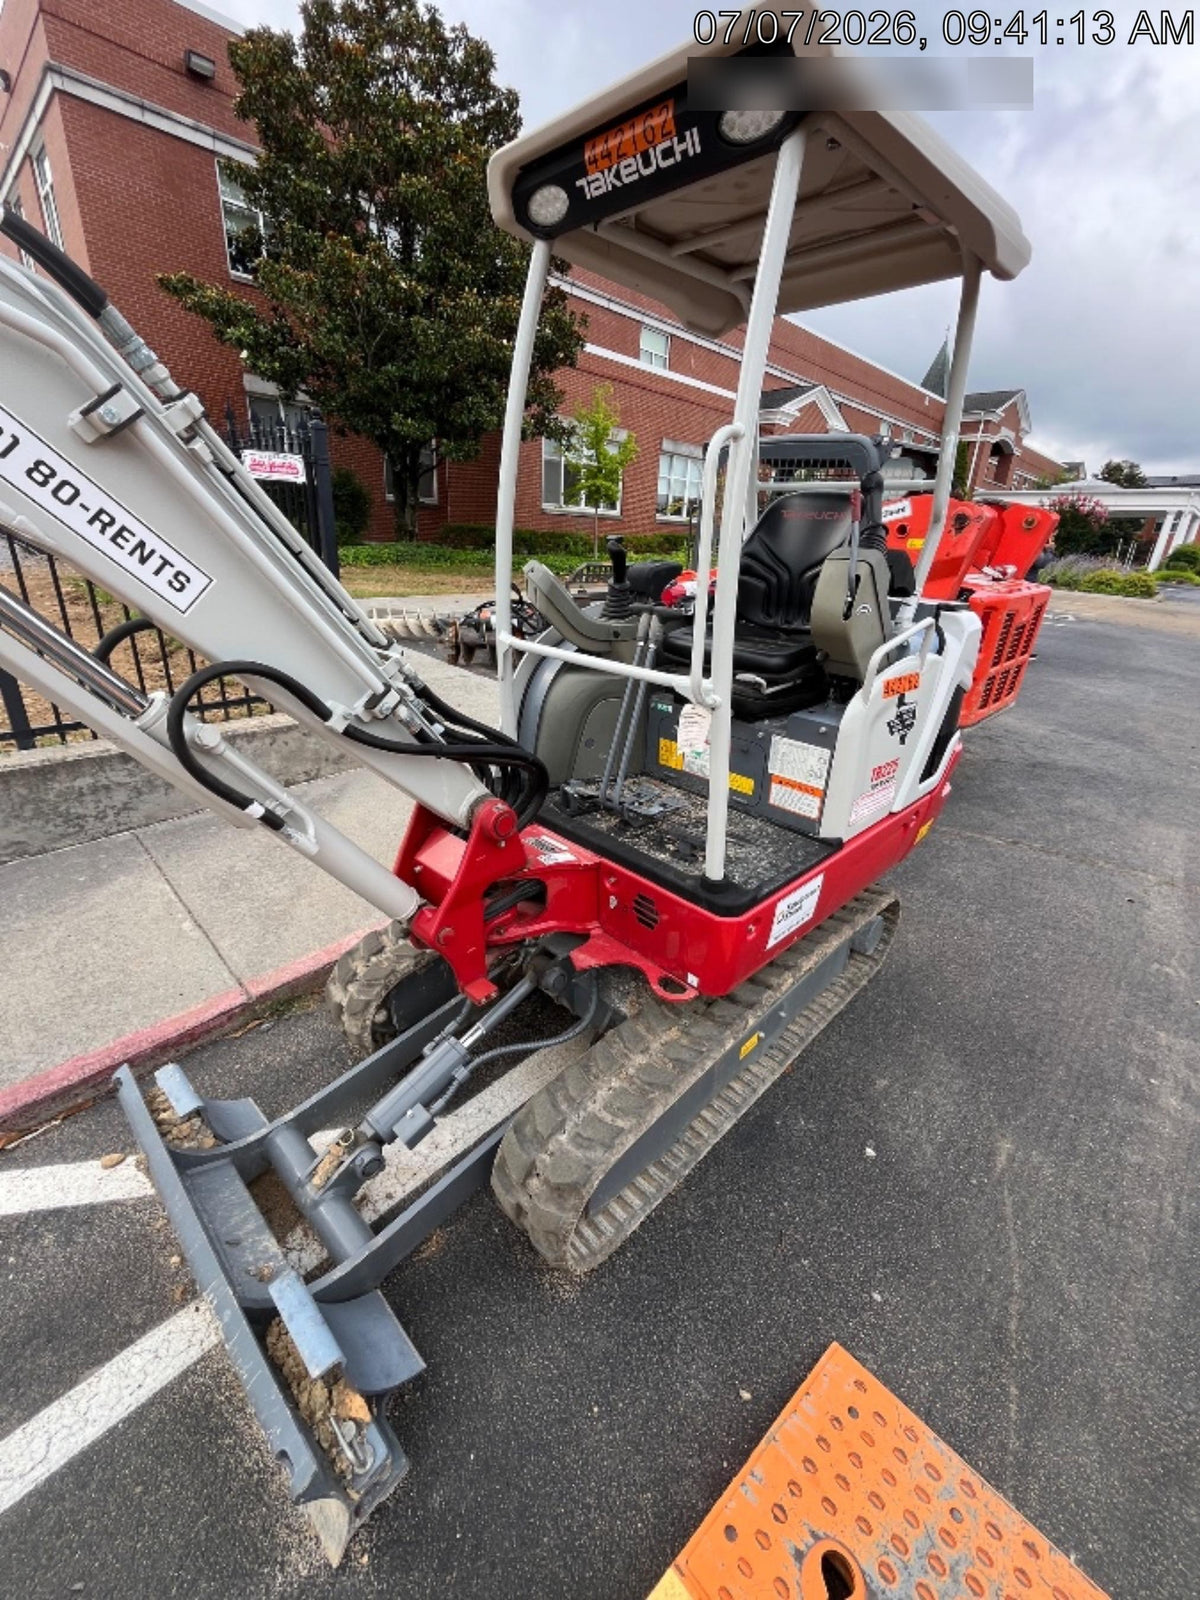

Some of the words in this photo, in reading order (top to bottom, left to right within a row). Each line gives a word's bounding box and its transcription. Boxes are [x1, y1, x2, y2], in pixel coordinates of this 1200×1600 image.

[575, 126, 702, 200] TAKEUCHI
[586, 103, 673, 169] 442162
[24, 459, 192, 594] 80-RENTS
